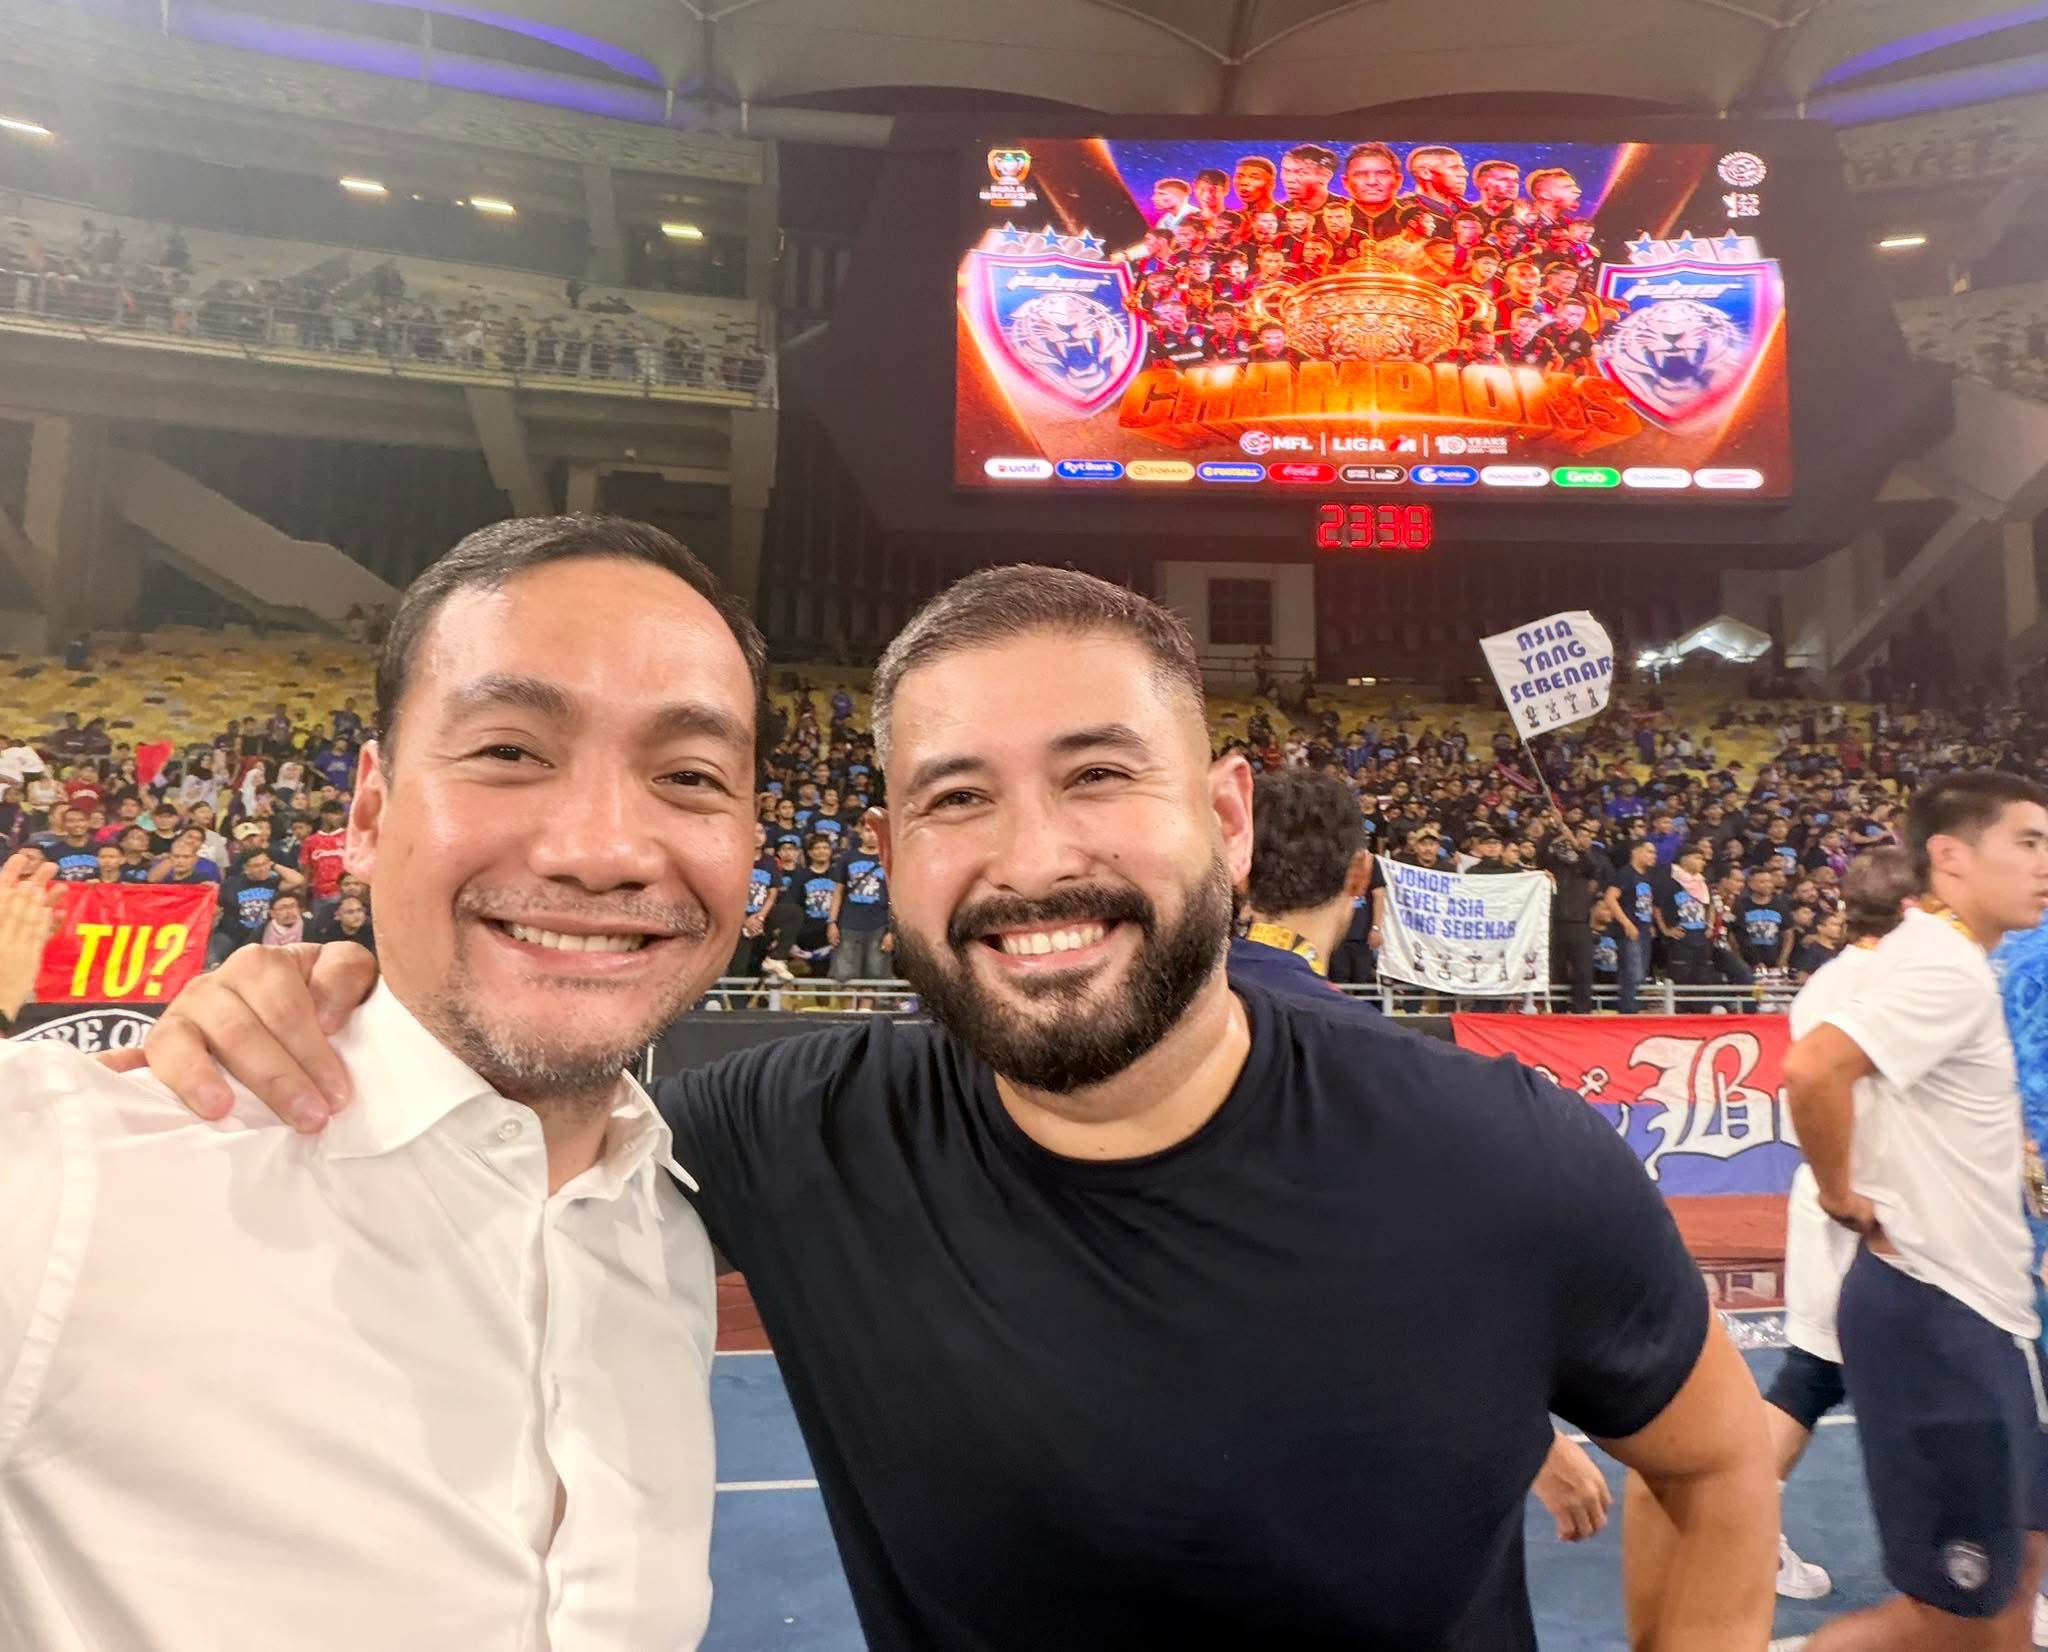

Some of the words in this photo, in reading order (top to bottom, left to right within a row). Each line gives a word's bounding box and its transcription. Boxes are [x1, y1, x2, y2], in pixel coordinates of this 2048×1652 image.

[1119, 361, 1642, 440] CHAMPIONS
[1273, 436, 1314, 451] MFL
[1332, 437, 1385, 452] LIGA
[1566, 470, 1607, 483] Grab
[1318, 504, 1431, 549] 2338
[1517, 620, 1573, 651] ASIA
[1519, 640, 1586, 675] YANG
[1510, 656, 1612, 704] SEBENAR
[1394, 887, 1440, 915] LEVEL
[1446, 897, 1485, 919] ASIA
[1442, 919, 1517, 941] SEBENAR
[70, 923, 189, 998] TU?
